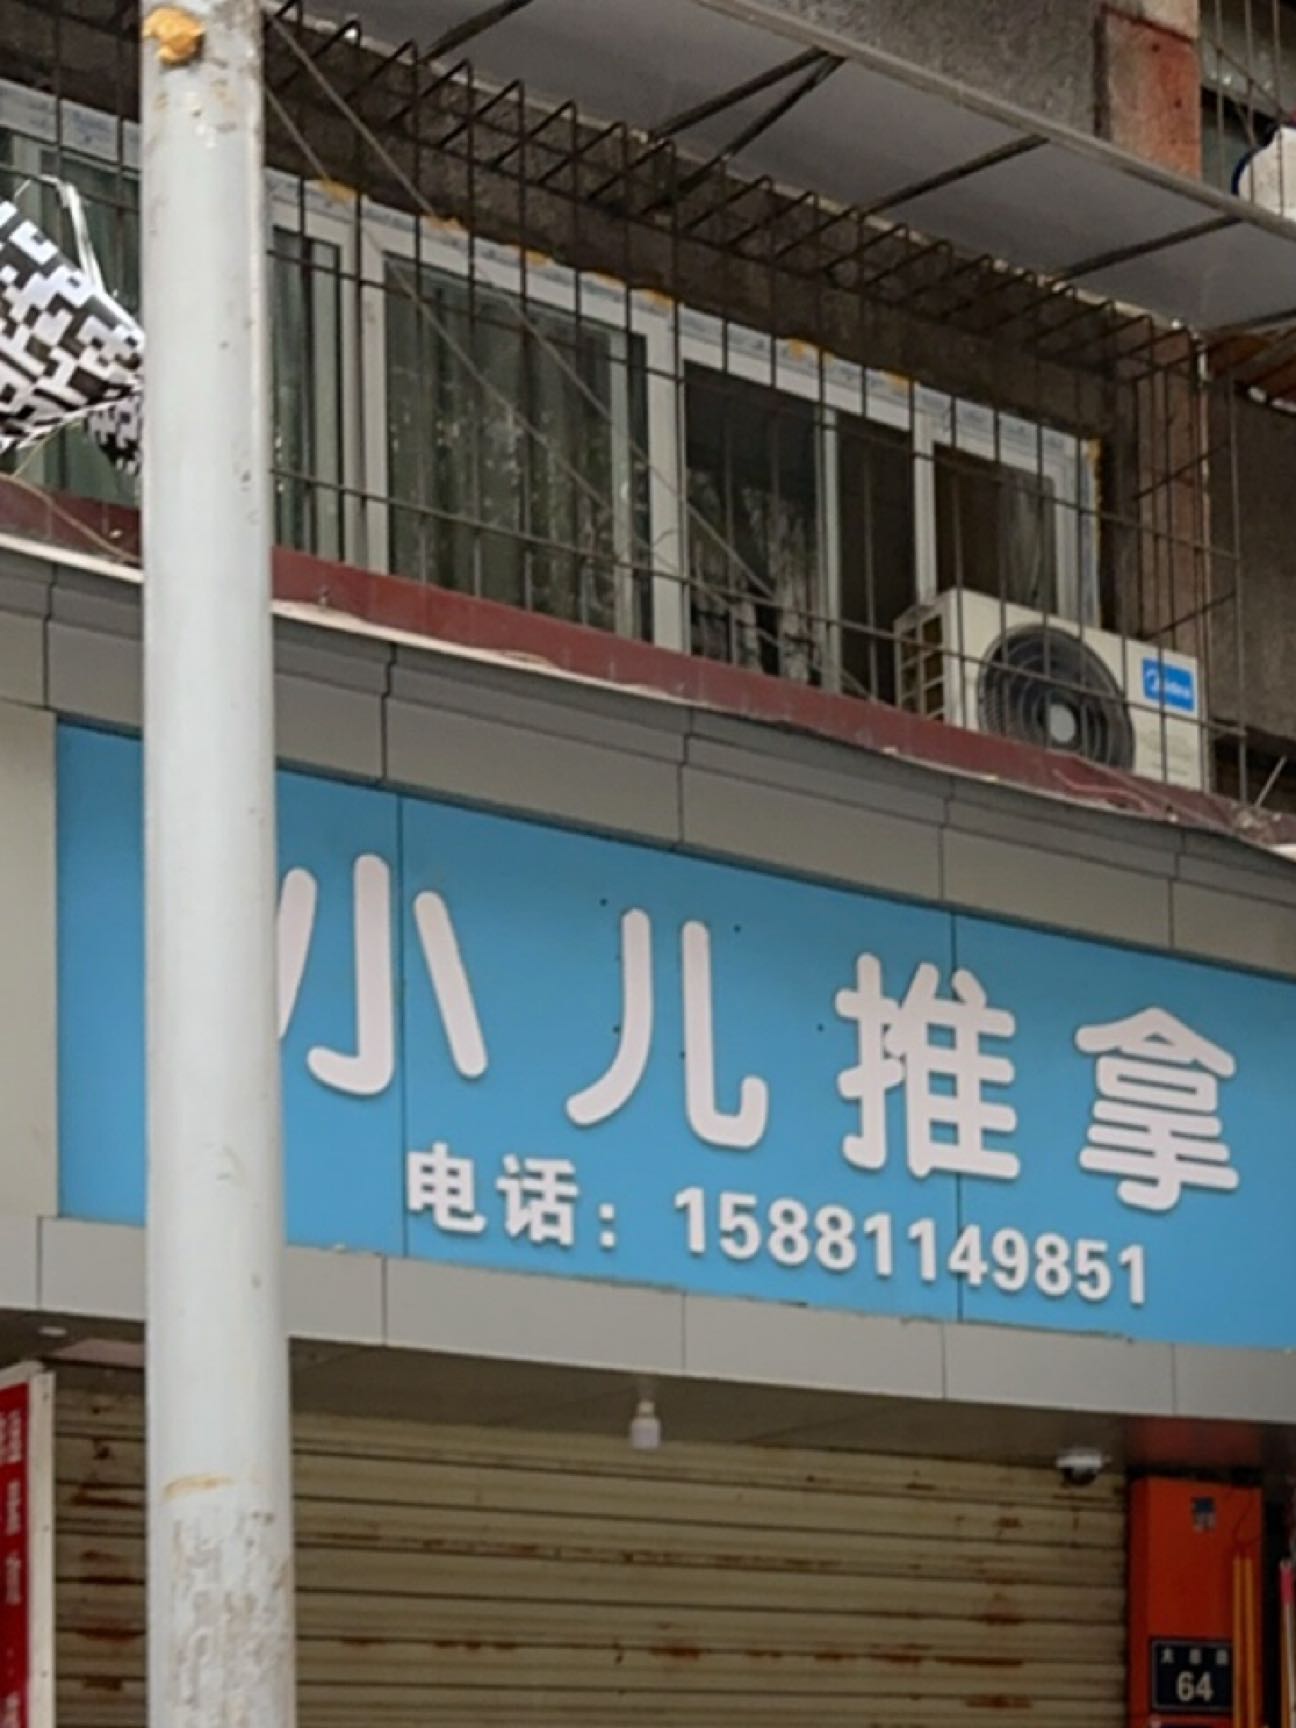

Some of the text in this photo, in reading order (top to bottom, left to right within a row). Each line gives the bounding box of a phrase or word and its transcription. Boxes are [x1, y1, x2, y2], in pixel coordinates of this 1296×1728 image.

[277, 854, 1239, 1211] 小儿推拿
[1177, 1671, 1214, 1702] 64
